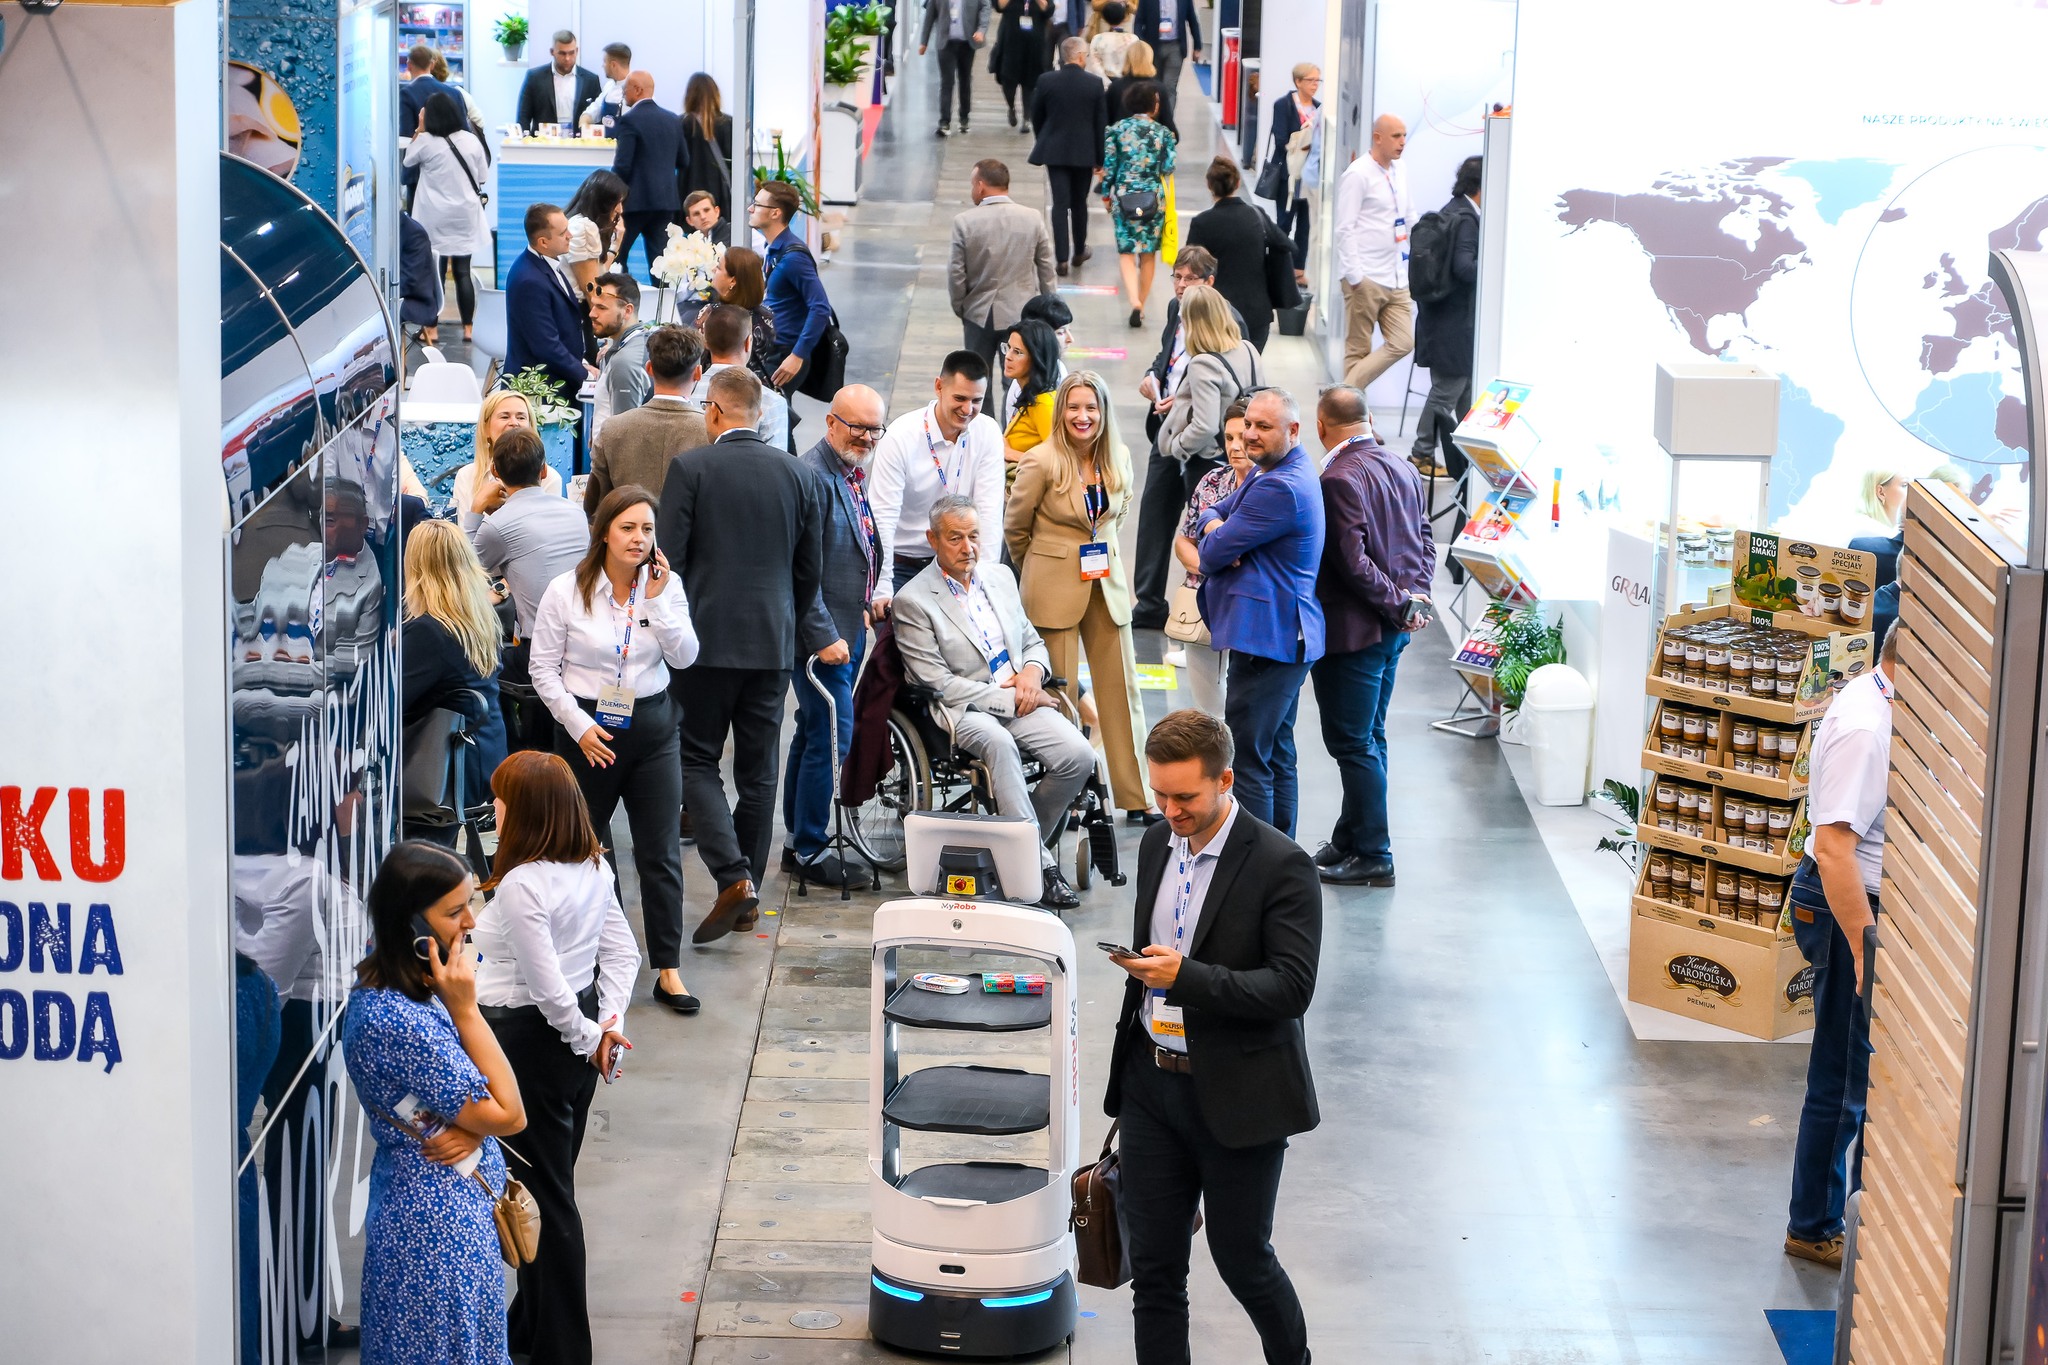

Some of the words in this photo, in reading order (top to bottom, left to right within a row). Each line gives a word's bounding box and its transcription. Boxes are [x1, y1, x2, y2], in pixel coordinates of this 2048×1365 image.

[1862, 114, 1905, 125] NASZE
[1752, 536, 1777, 550] 100%
[1751, 546, 1777, 558] SMAKU
[1833, 551, 1861, 562] POLSKIE
[1831, 559, 1863, 570] SPECJAŁY
[1751, 616, 1772, 628] 100%
[1813, 641, 1830, 652] 100%
[1813, 650, 1830, 660] SMAKU
[600, 699, 631, 711] SUEMPOL
[0, 785, 126, 883] KU
[941, 902, 977, 911] MyRobo
[1683, 955, 1721, 976] Kuchnia
[1671, 963, 1733, 989] STAROPOLSKA
[1686, 996, 1716, 1010] PREMIUM
[0, 988, 123, 1075] ODĄ
